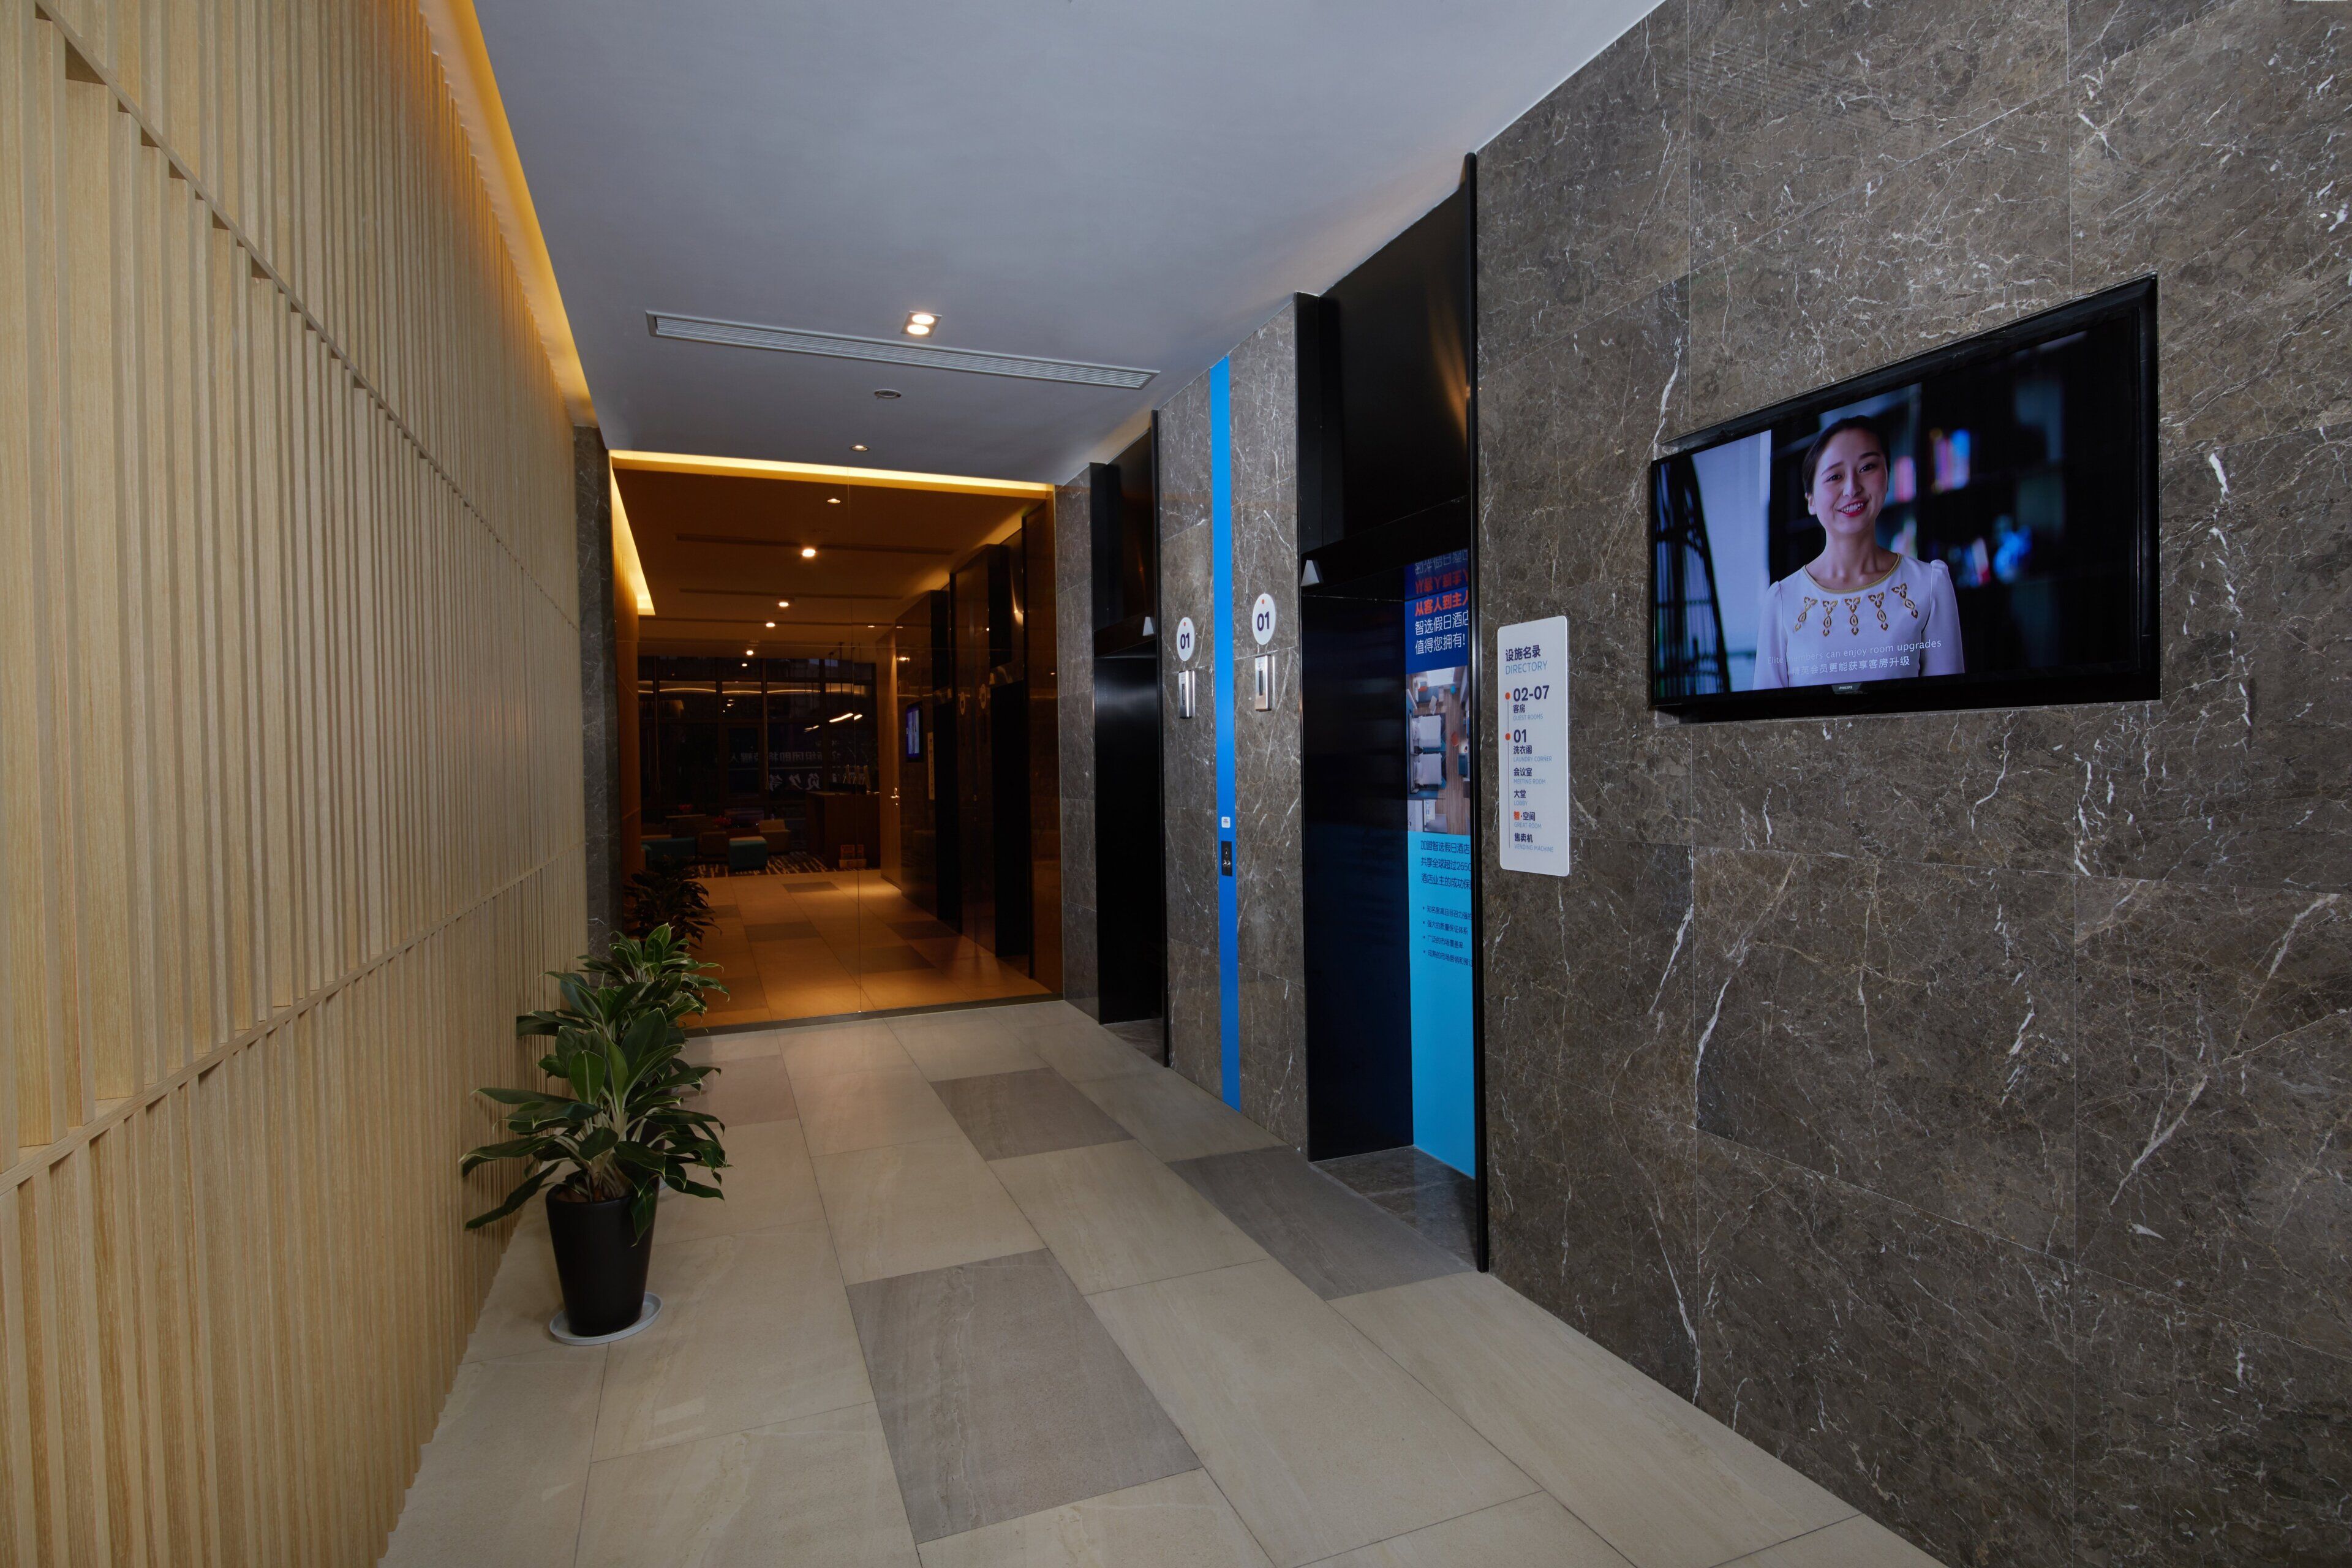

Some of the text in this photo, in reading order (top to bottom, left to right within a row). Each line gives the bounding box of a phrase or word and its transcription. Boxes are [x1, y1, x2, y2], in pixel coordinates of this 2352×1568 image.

[1257, 611, 1270, 631] 01
[1180, 633, 1189, 649] 01
[1506, 645, 1540, 662] 设施名录
[1787, 650, 1823, 663] members
[1843, 647, 1866, 658] enjoy
[1870, 645, 1893, 654] room
[1897, 639, 1942, 652] upgrades
[1506, 661, 1548, 674] DIRECTORY
[1792, 655, 1910, 676] 精英会员更能获享客房升级
[1513, 685, 1550, 702] 02-07
[1513, 704, 1525, 714] 客房
[1513, 729, 1526, 743] 01
[1513, 745, 1532, 754] 洗衣阁
[1513, 767, 1532, 777] 会议室
[1514, 789, 1526, 798] 大堂
[1514, 833, 1533, 843] 售卖机
